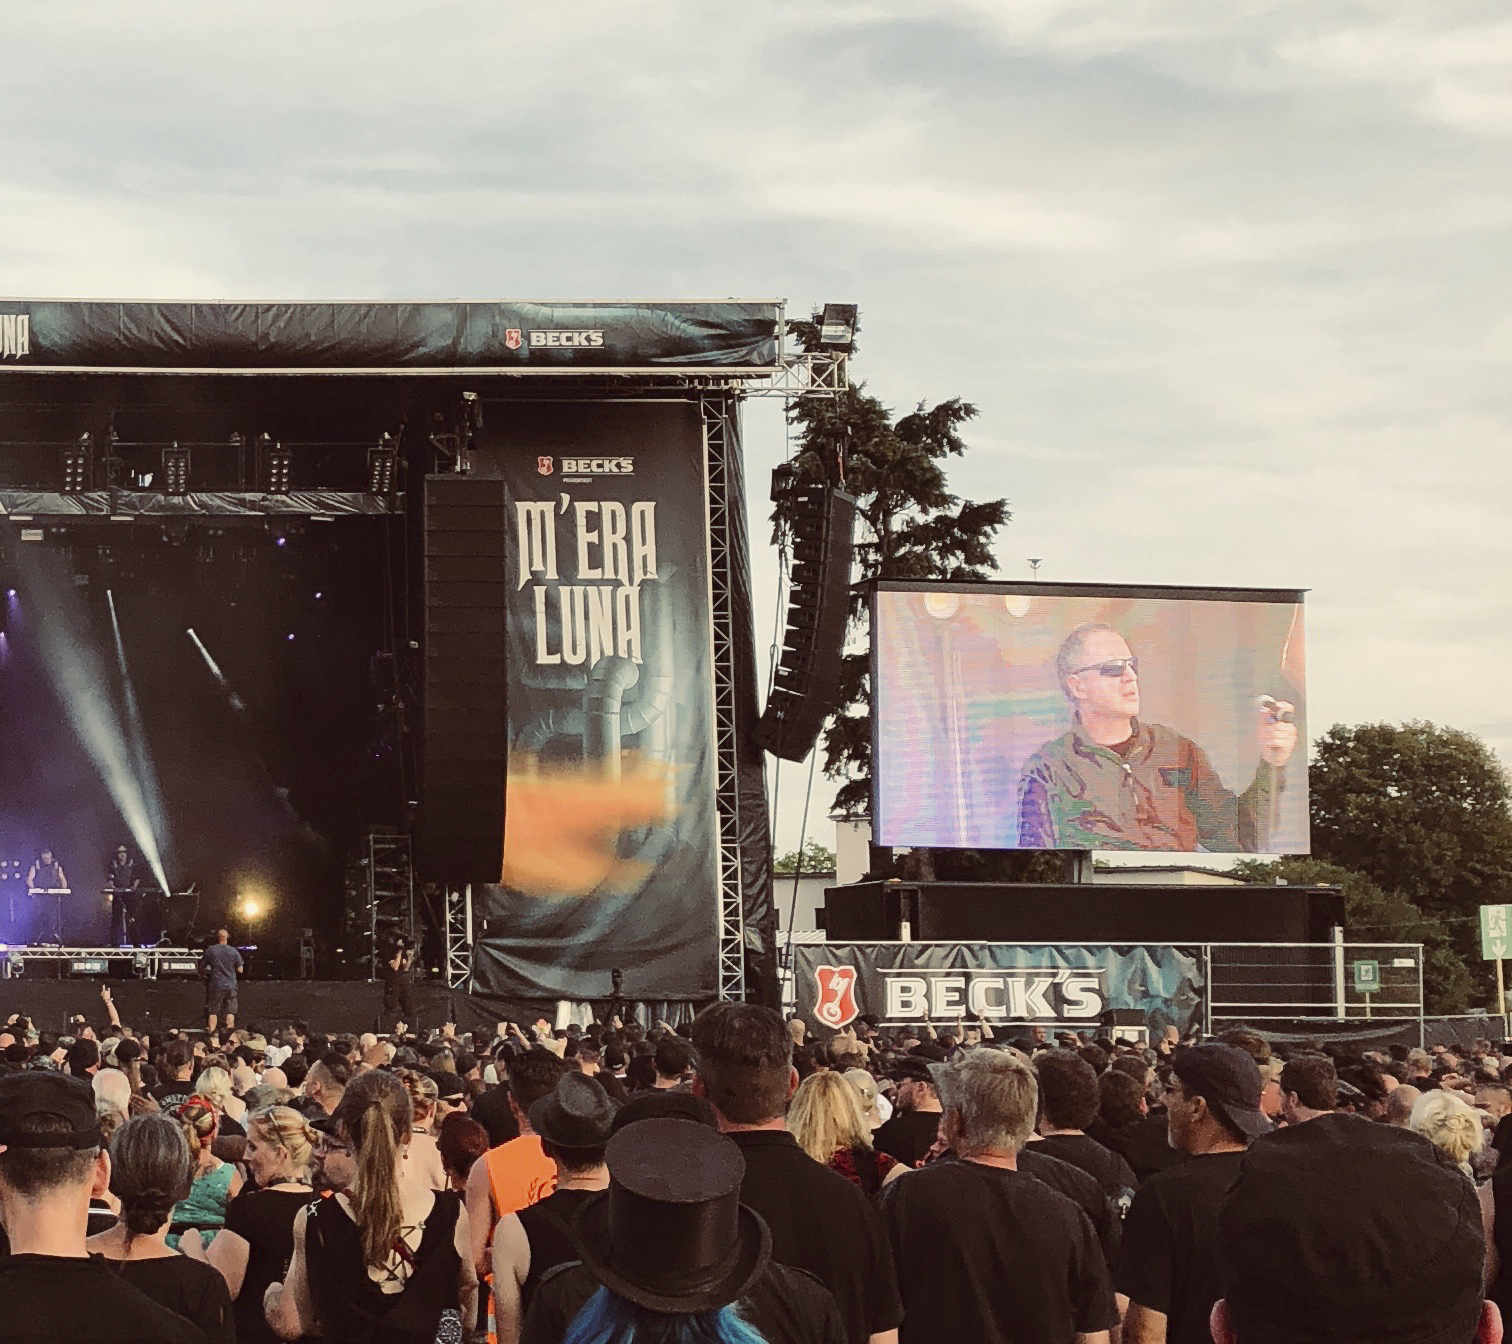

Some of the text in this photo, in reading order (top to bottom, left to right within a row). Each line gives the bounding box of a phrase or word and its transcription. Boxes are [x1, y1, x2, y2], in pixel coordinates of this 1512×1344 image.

[529, 330, 604, 346] BECK'S
[562, 457, 634, 473] BECK'S
[515, 492, 659, 592] M'ERA
[533, 585, 643, 670] LUNA
[885, 969, 1103, 1019] BECK'S
